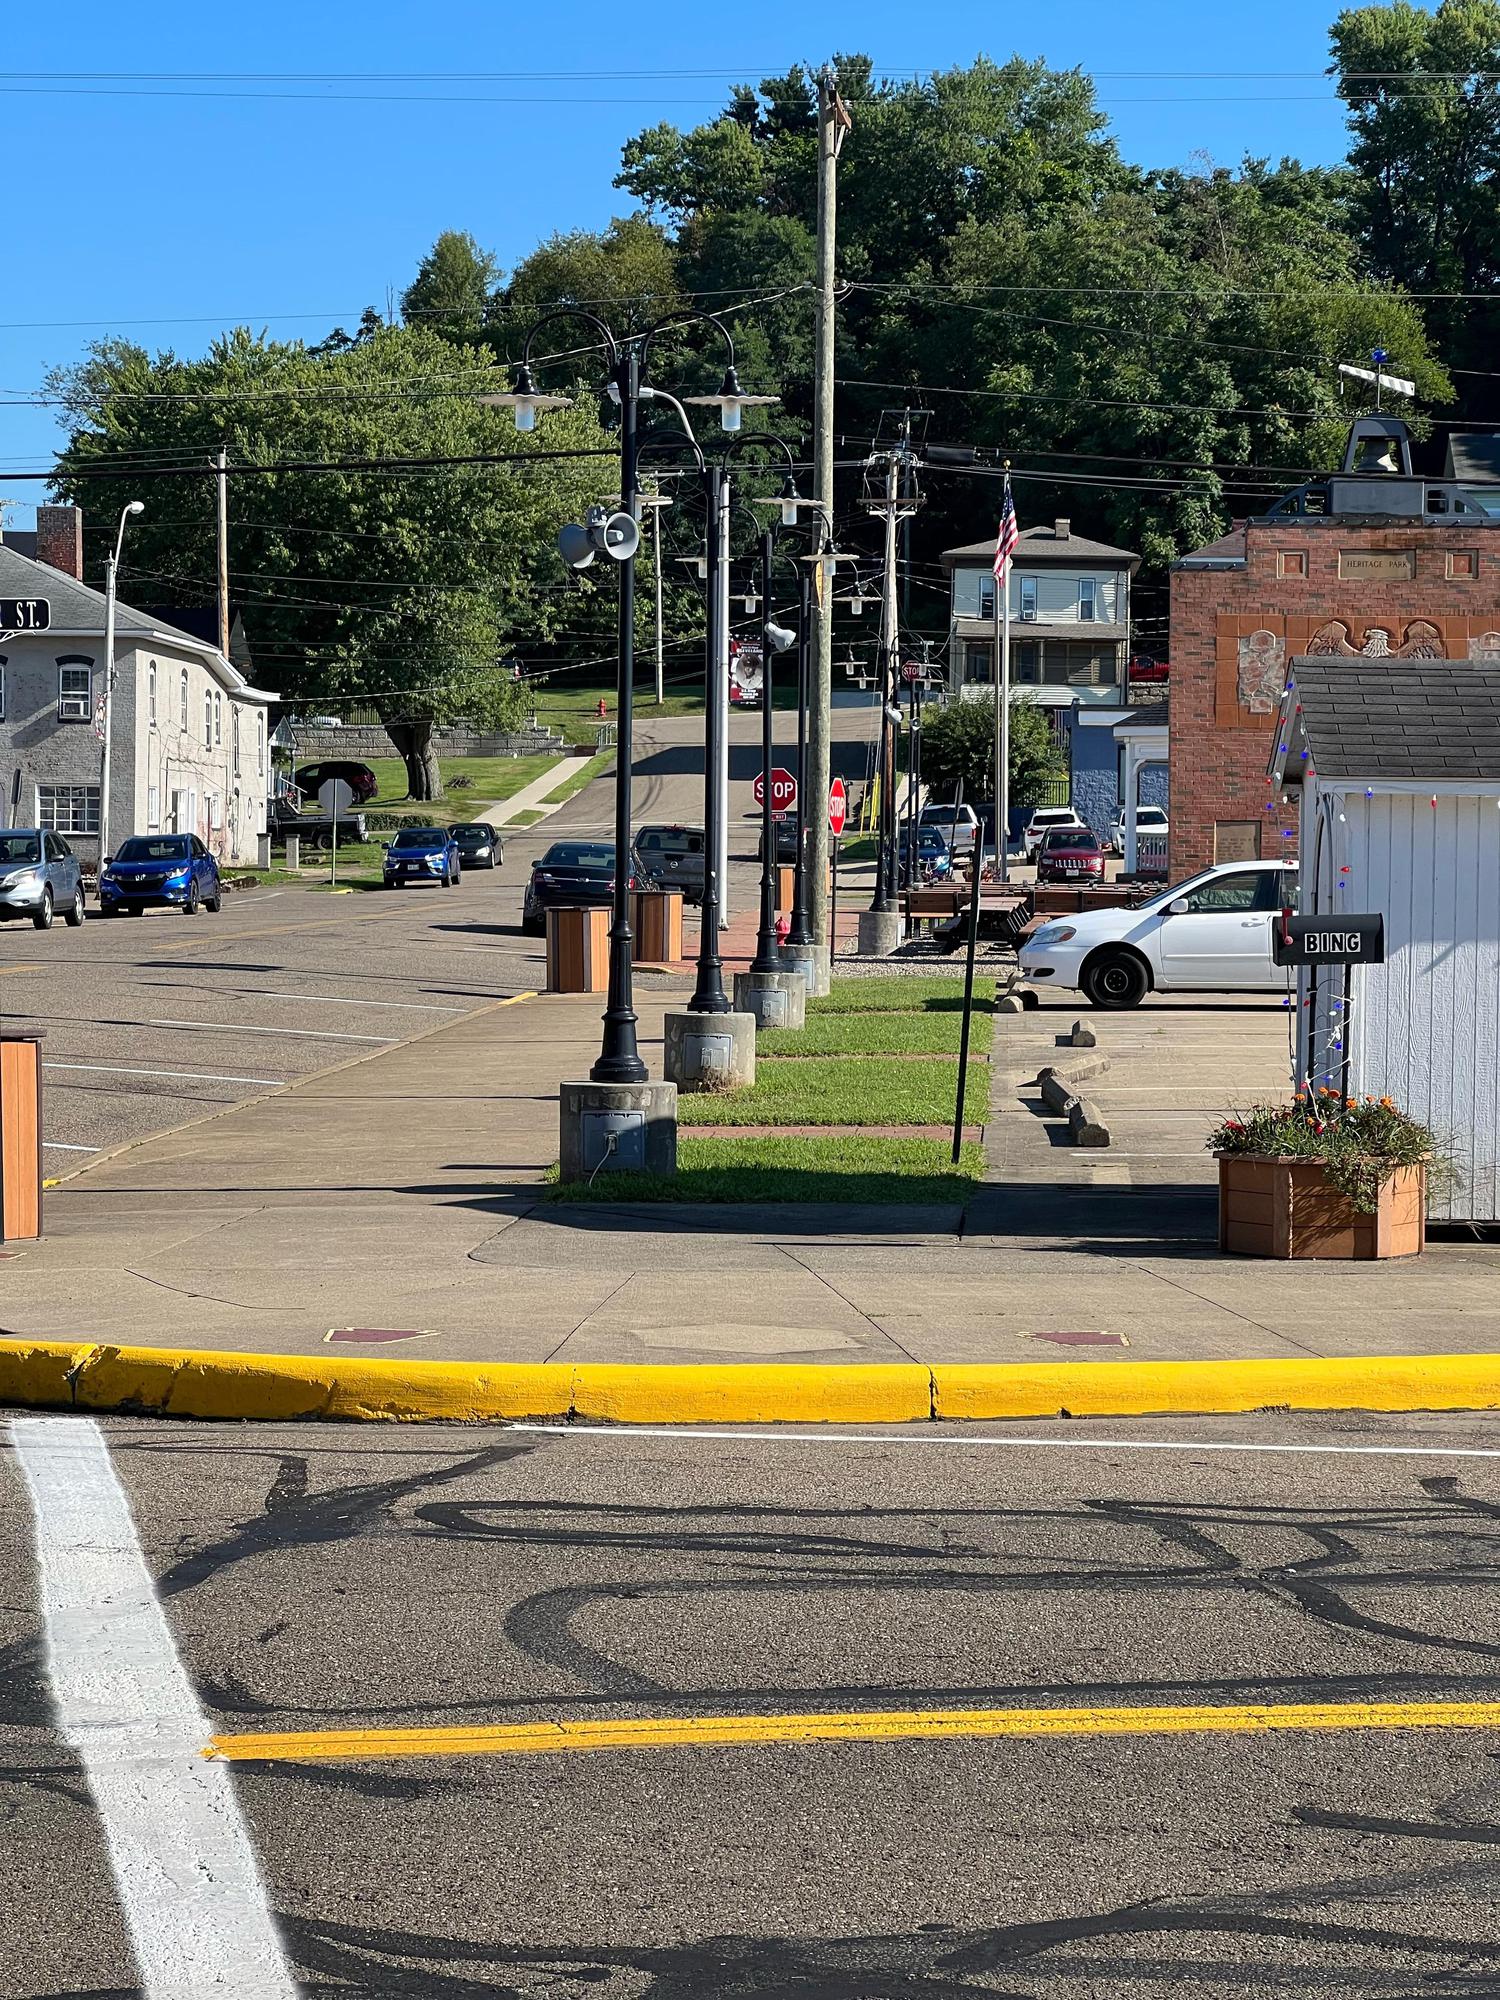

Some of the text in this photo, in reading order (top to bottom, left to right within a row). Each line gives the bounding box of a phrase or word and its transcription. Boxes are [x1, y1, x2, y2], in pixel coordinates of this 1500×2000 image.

[1347, 560, 1408, 568] HERITAGE PARK
[16, 601, 40, 628] ST.
[756, 782, 794, 798] SOP
[830, 796, 844, 818] STOP
[1306, 933, 1360, 952] BING
